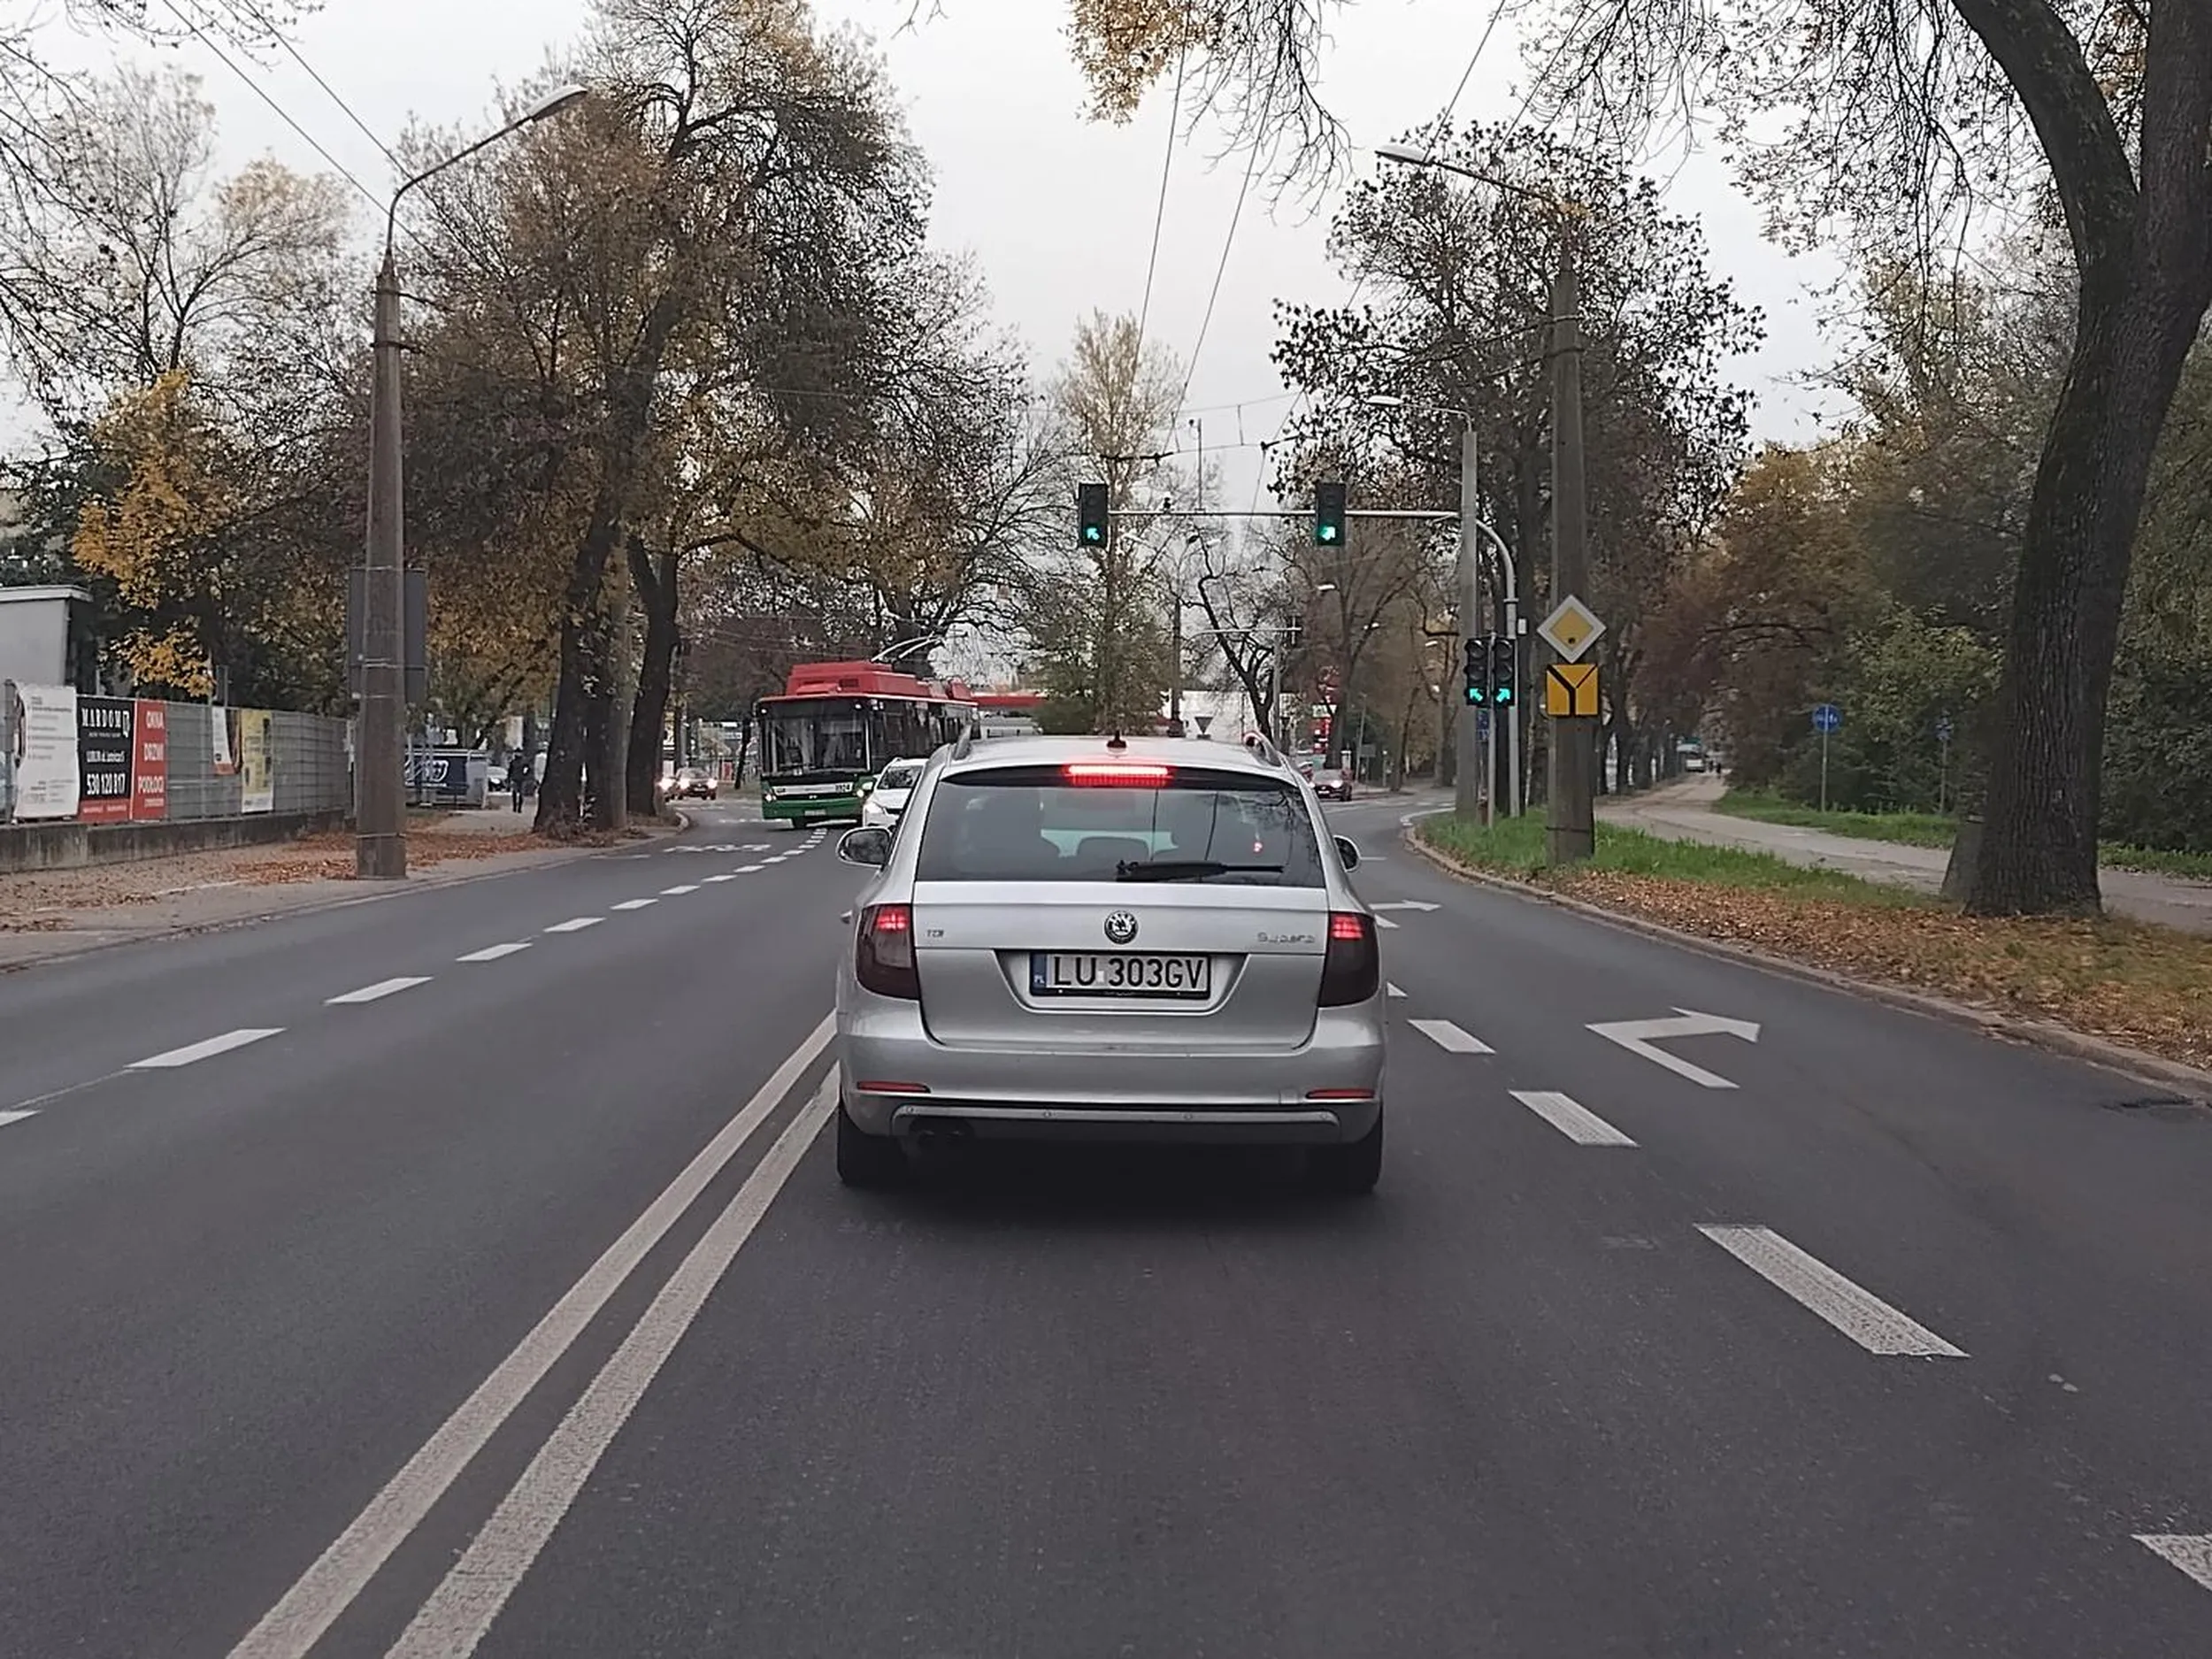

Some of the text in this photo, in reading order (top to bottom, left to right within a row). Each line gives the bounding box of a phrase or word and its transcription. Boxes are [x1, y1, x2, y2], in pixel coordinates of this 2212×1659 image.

[81, 708, 122, 728] MARDOM
[1053, 956, 1204, 989] LU 303GV
